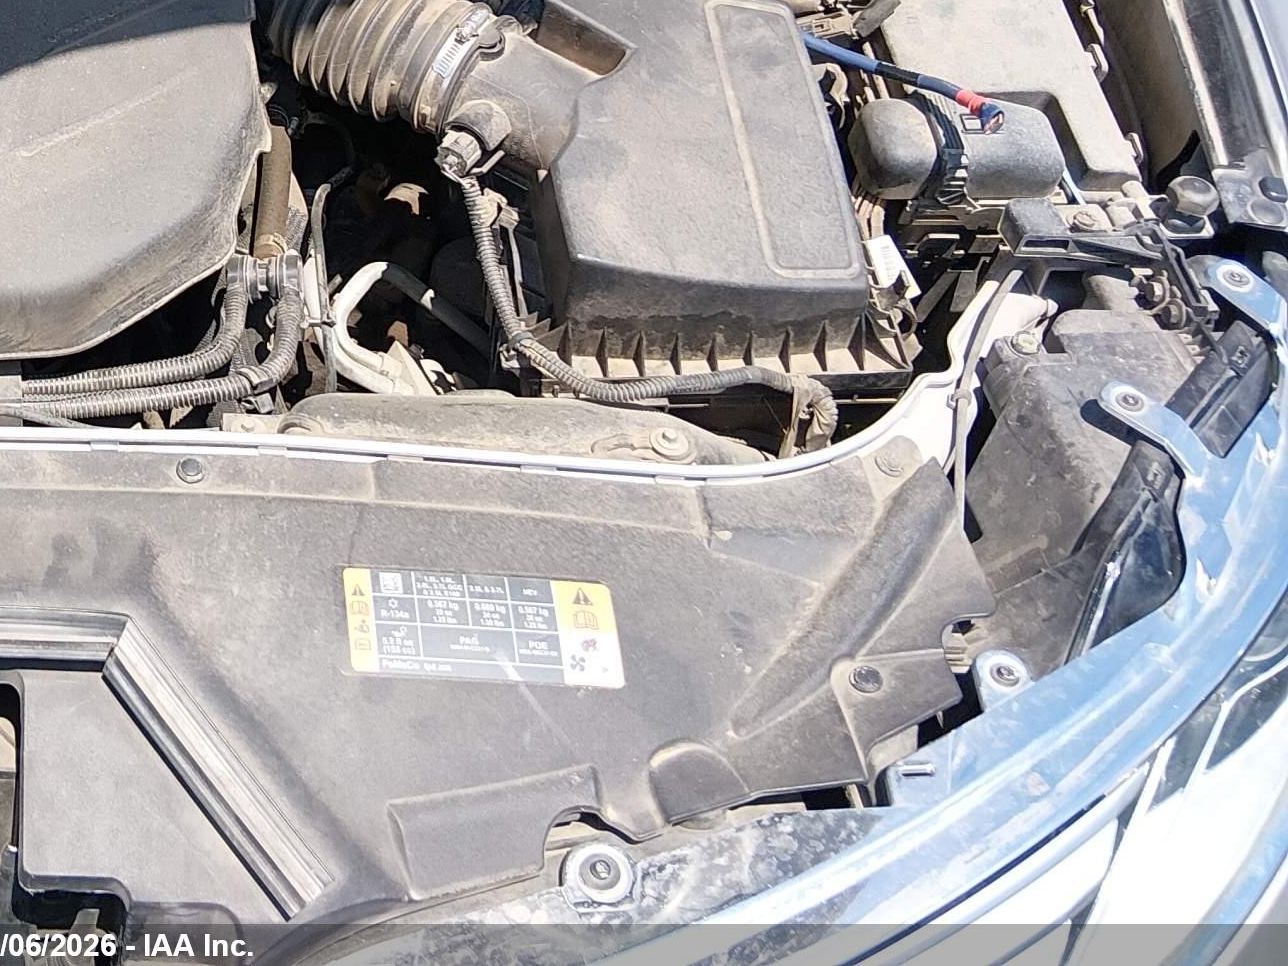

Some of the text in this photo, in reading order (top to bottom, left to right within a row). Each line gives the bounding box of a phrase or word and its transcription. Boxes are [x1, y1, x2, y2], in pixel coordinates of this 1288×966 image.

[448, 599, 459, 611] kg
[380, 608, 410, 619] R-134a
[459, 635, 480, 645] PAG
[528, 640, 549, 650] POE
